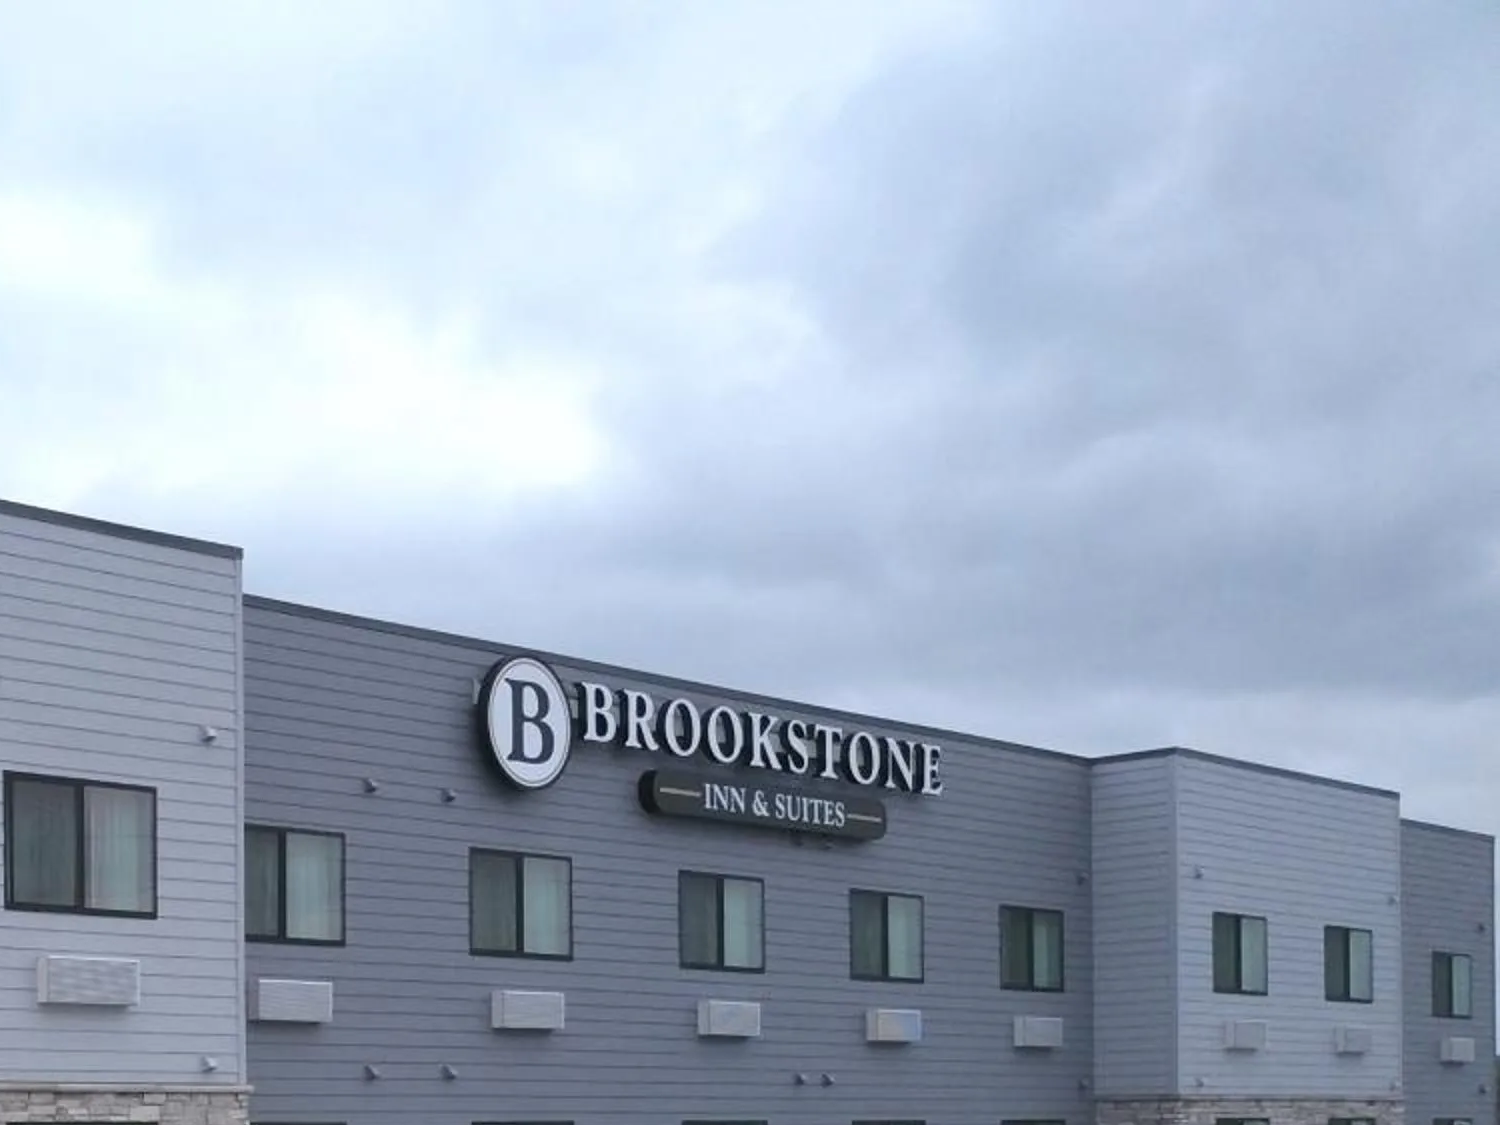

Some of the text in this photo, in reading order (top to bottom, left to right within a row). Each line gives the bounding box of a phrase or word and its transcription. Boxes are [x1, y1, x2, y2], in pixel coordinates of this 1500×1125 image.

[505, 678, 556, 764] B
[581, 681, 944, 796] BROOKSTONE
[703, 783, 846, 828] INN & SUITES
